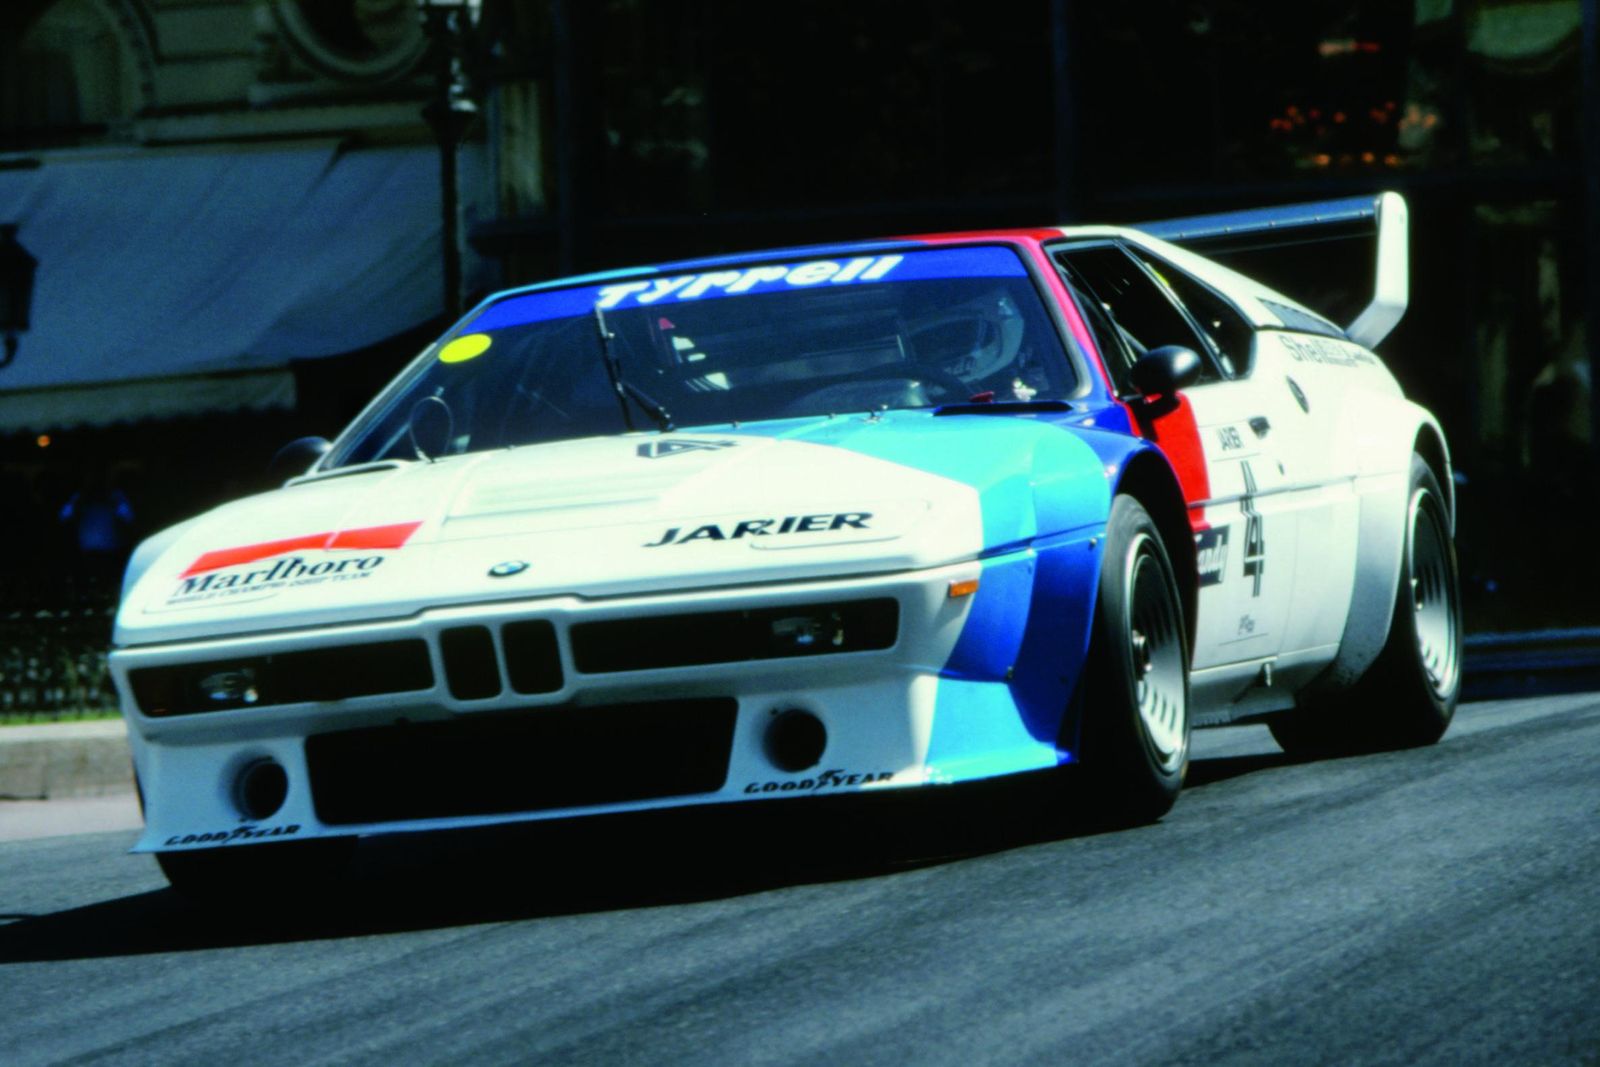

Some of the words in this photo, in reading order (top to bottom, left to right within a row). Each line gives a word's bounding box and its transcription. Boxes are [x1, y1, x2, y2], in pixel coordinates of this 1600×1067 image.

[636, 438, 740, 459] 4
[641, 511, 873, 547] JARIER
[1239, 460, 1264, 598] 4
[172, 555, 385, 597] Marlboro
[1195, 533, 1228, 583] andy
